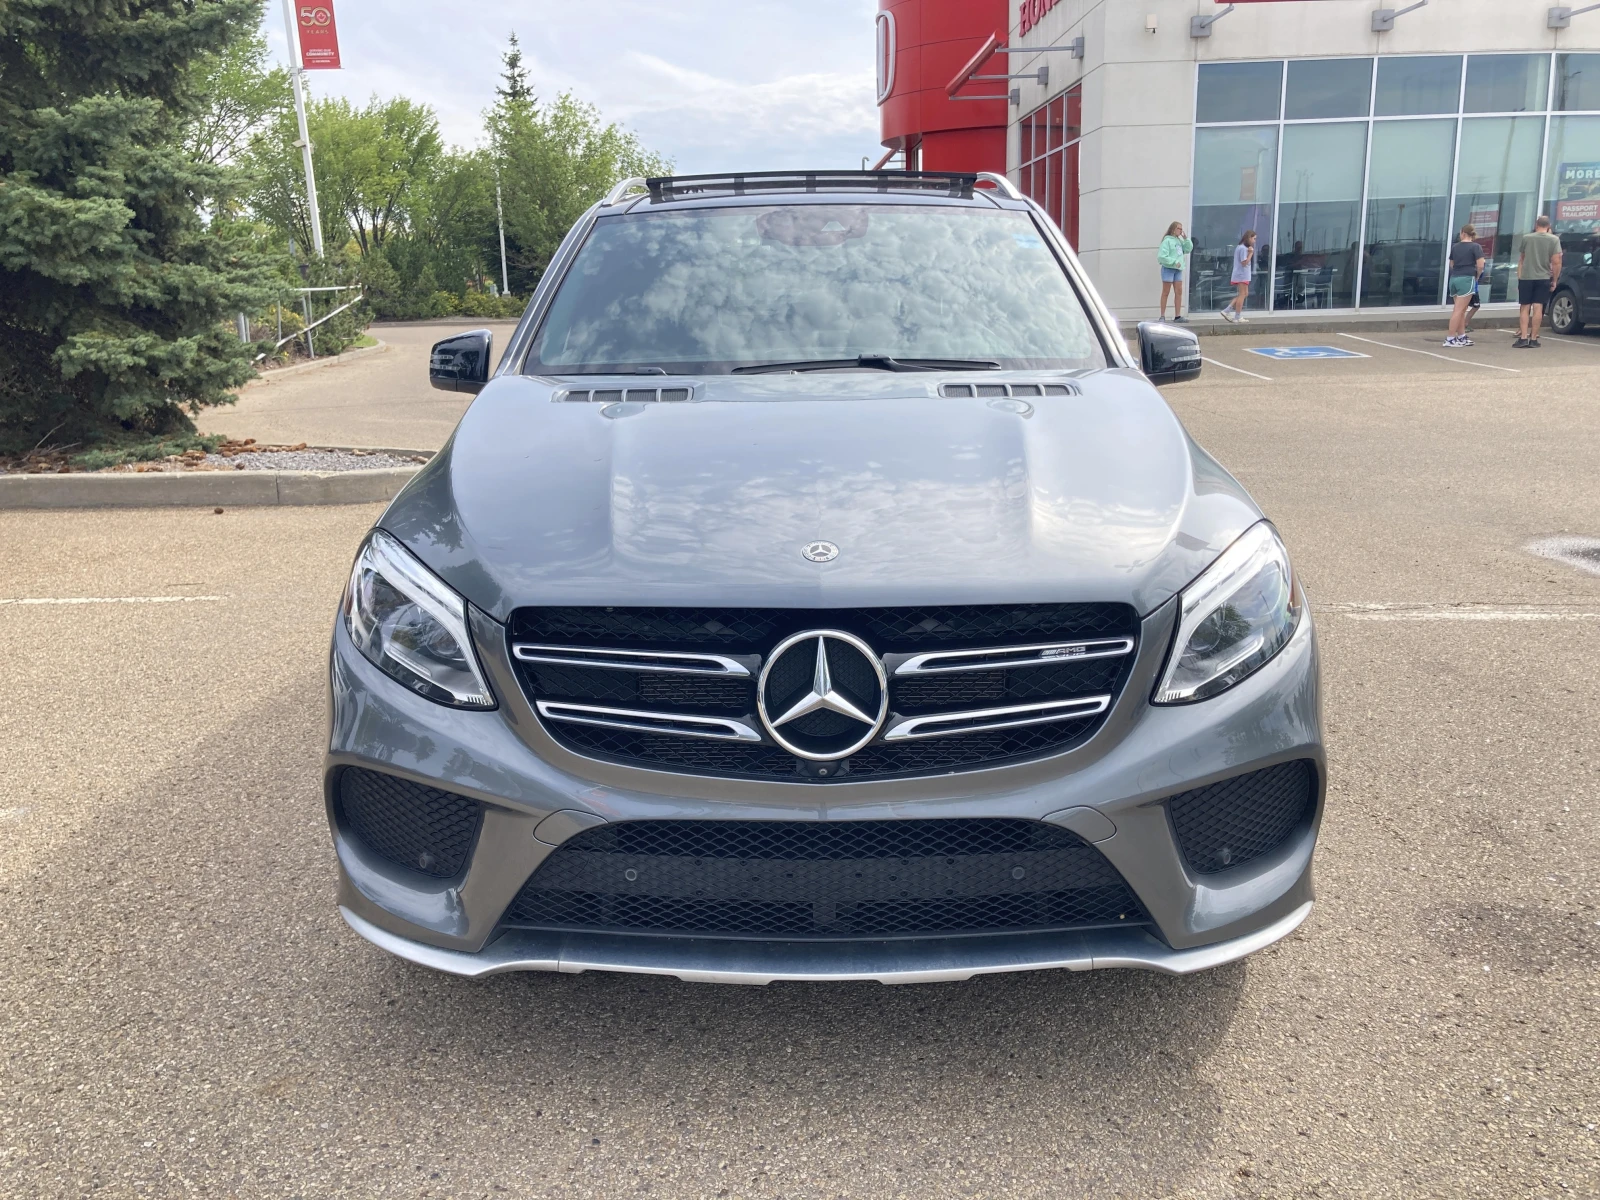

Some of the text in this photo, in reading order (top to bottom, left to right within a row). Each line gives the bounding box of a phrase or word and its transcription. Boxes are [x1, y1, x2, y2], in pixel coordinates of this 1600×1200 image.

[301, 6, 331, 27] 50
[1565, 169, 1600, 179] MORE
[1055, 646, 1086, 655] AMG
